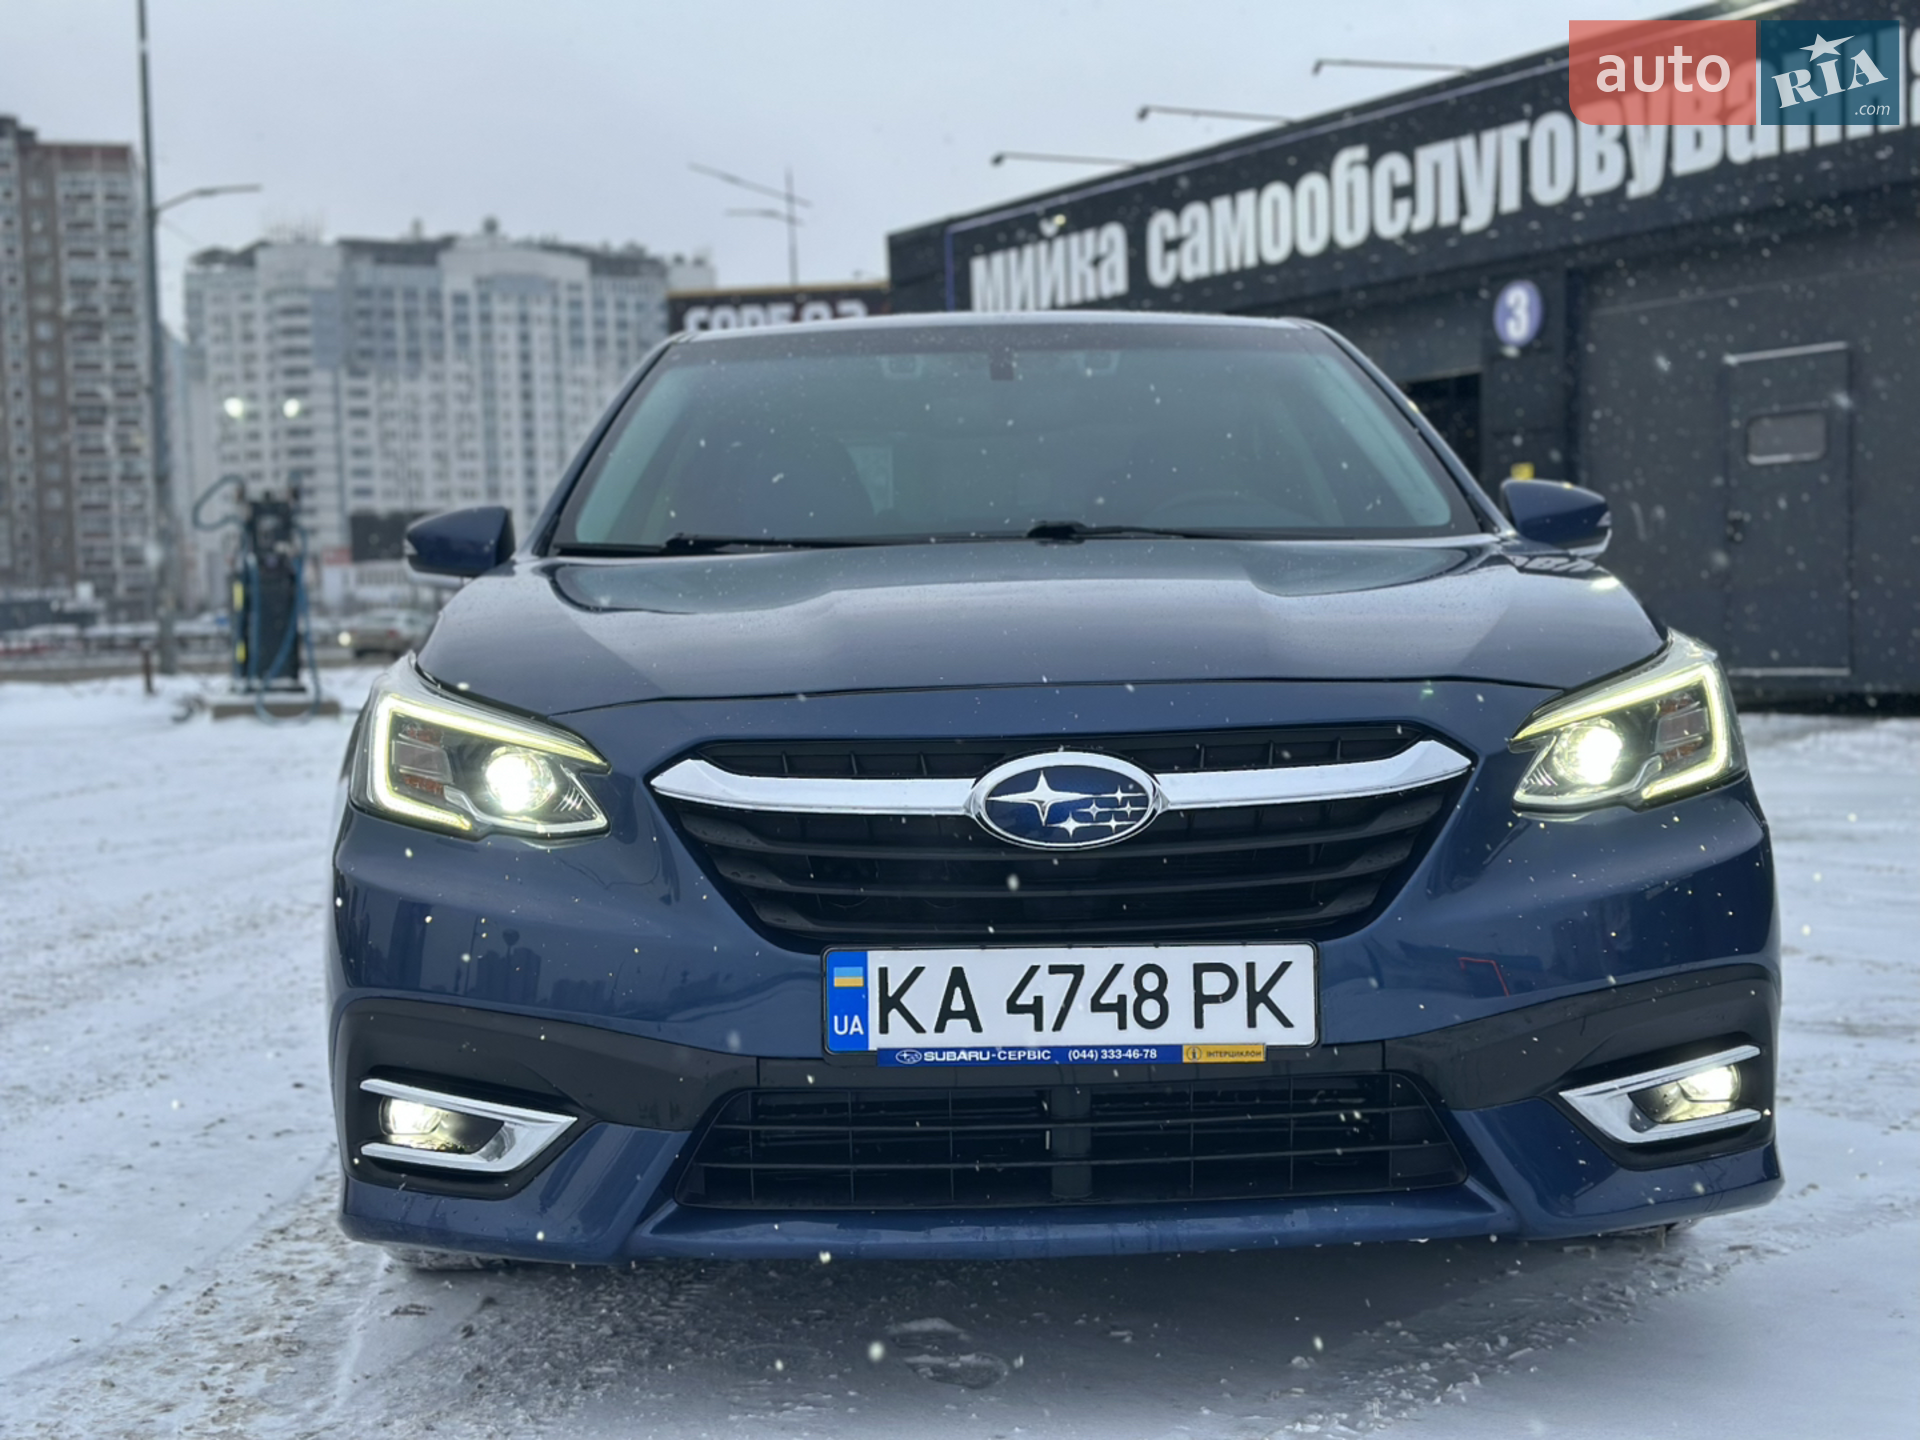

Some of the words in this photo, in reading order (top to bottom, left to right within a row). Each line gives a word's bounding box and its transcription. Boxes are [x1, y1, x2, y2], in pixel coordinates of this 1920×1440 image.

[970, 217, 1129, 312] мийка
[1505, 285, 1530, 341] 3
[833, 1014, 864, 1036] UA
[878, 966, 983, 1034] KA
[1006, 963, 1169, 1032] 4748
[1192, 961, 1295, 1029] PK
[1067, 1049, 1098, 1062] (044)
[1100, 1048, 1158, 1060] 333-46-78
